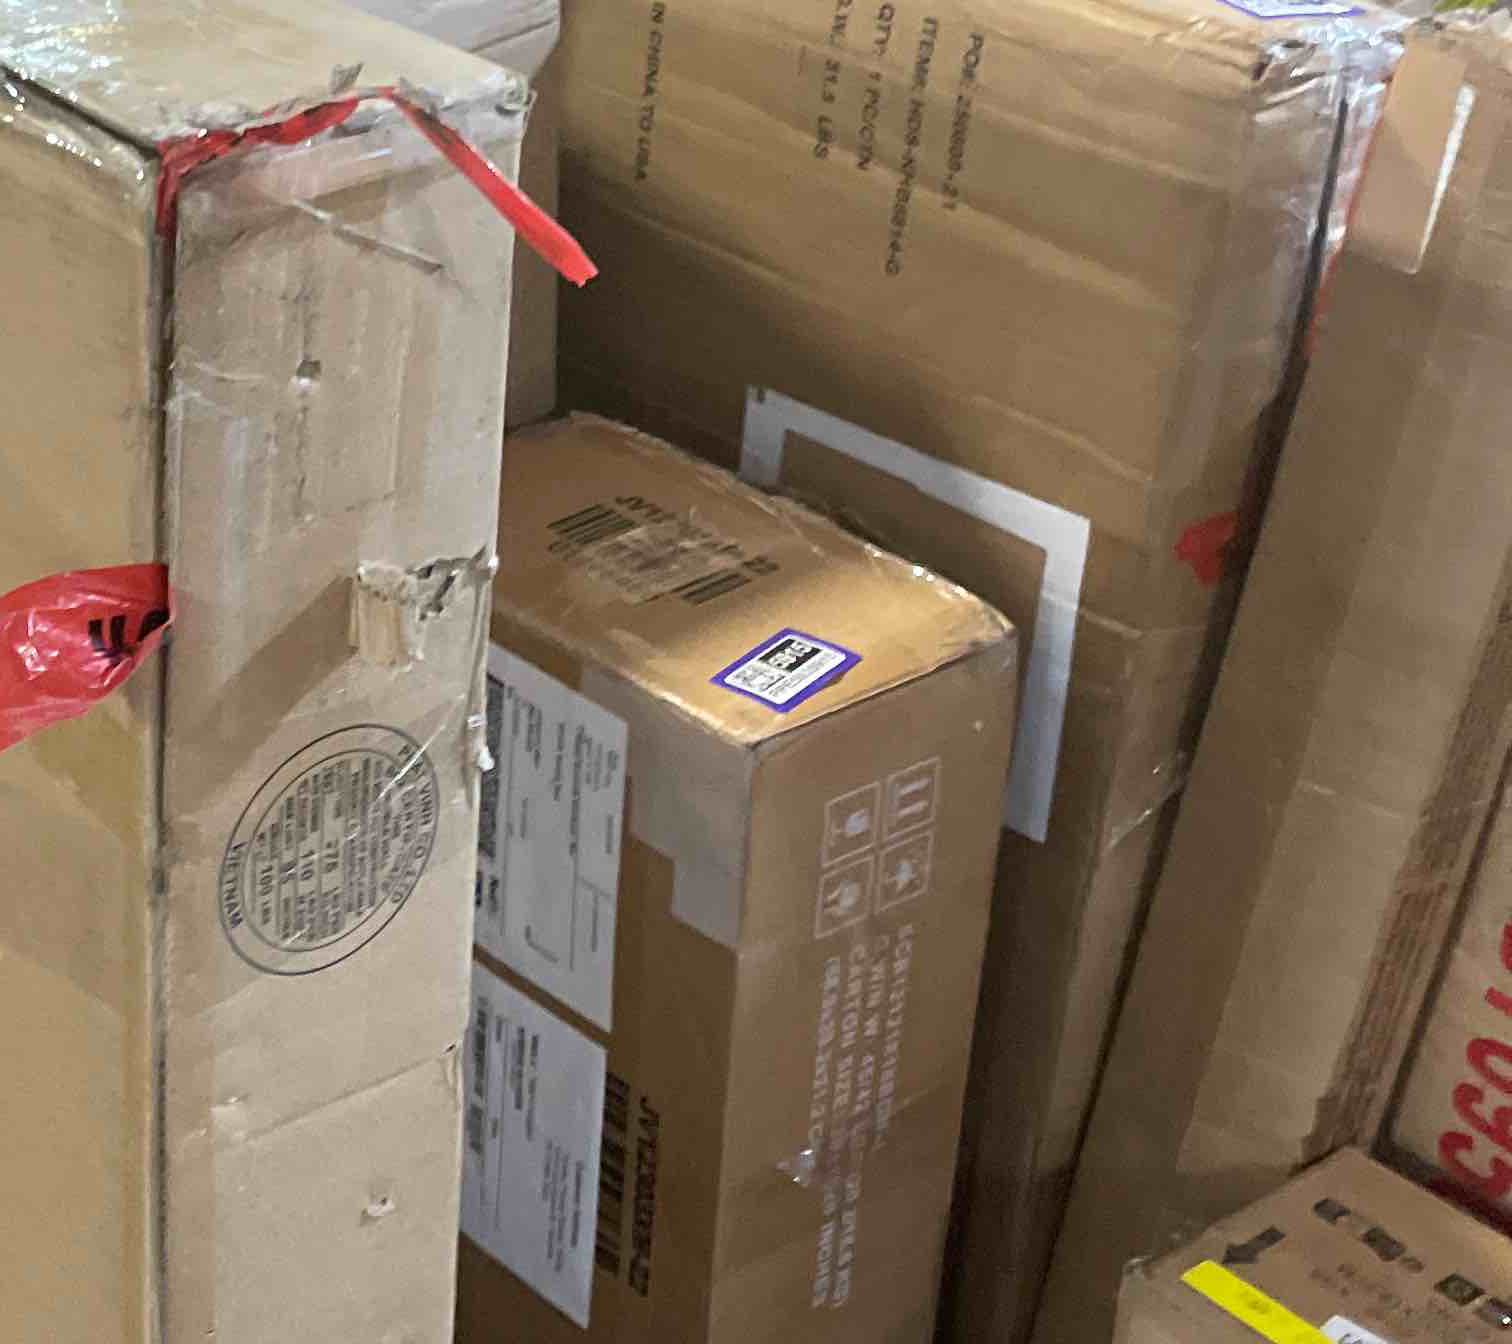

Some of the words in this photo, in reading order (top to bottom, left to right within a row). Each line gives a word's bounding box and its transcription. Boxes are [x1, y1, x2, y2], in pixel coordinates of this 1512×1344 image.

[650, 1, 667, 25] IN
[642, 30, 663, 96] CHINA
[639, 105, 655, 133] TO
[812, 114, 834, 160] LBS
[223, 842, 249, 929] VIETNAM
